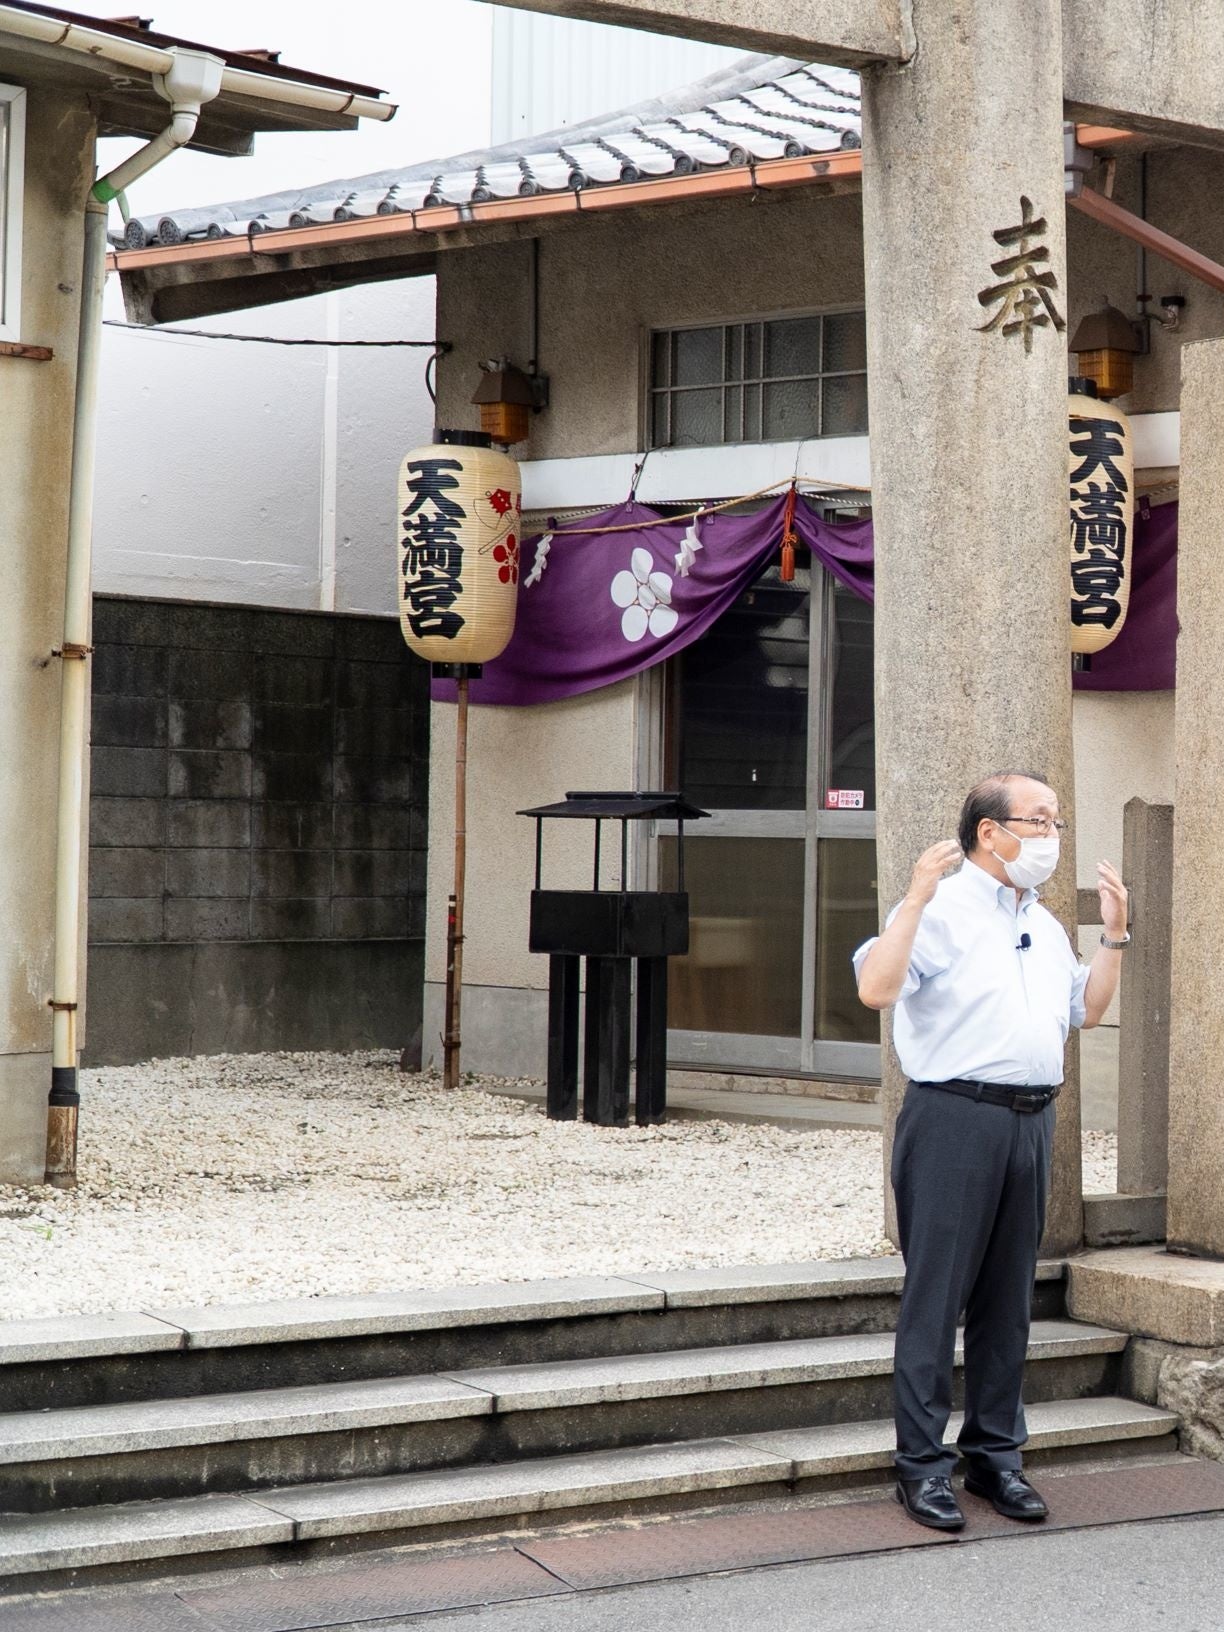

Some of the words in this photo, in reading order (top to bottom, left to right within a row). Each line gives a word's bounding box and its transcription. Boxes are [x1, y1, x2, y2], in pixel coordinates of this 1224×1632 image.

[968, 194, 1067, 356] 奉
[401, 458, 467, 640] 天満宮
[1068, 418, 1129, 630] 天満宮
